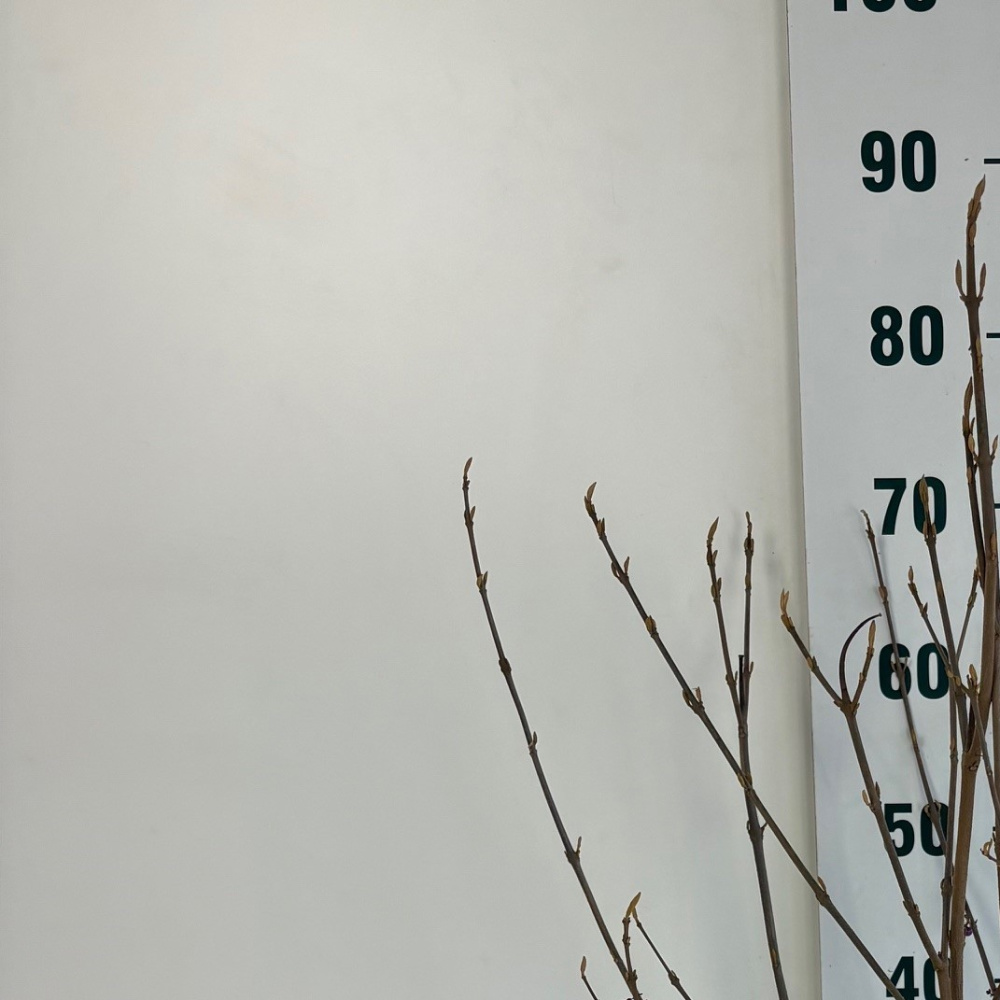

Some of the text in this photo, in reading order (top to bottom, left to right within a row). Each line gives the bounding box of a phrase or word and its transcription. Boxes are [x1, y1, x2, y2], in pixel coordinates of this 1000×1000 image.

[861, 130, 936, 192] 90
[870, 305, 944, 366] 80
[874, 476, 947, 535] 70
[879, 643, 949, 699] 60
[884, 803, 949, 857] 50
